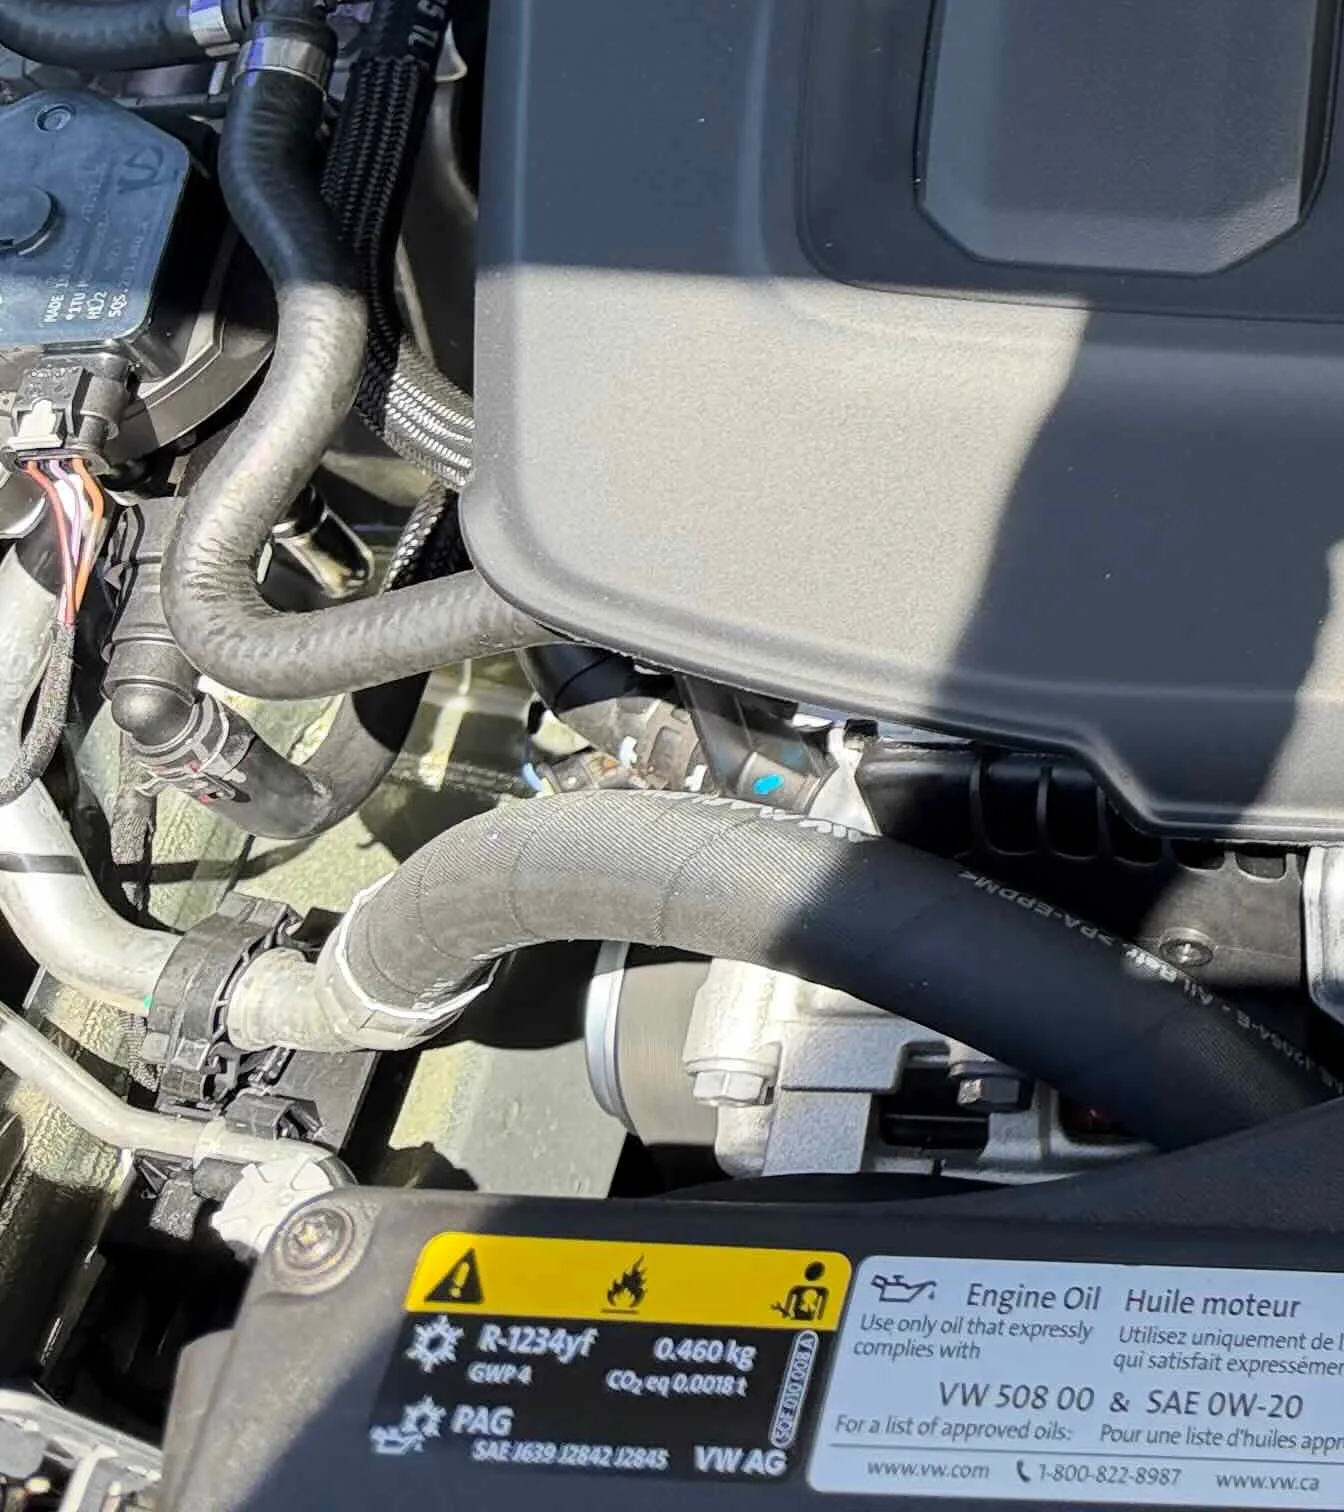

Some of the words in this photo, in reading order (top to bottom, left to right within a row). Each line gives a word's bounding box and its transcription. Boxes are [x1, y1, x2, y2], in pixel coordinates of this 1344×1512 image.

[966, 1282, 1057, 1314] Engine
[1063, 1286, 1099, 1311] Oil
[1125, 1289, 1194, 1316] Huile
[1202, 1295, 1300, 1320] moteur
[860, 1314, 894, 1332] Use
[897, 1316, 936, 1340] only
[940, 1316, 963, 1335] oil
[966, 1317, 1003, 1338] that
[1009, 1320, 1093, 1344] expressly
[1118, 1325, 1185, 1346] Utilisez
[1192, 1330, 1306, 1354] uniquement
[1310, 1333, 1334, 1352] de
[478, 1324, 599, 1364] R-1234yf
[655, 1336, 724, 1363] 0.460
[725, 1345, 757, 1371] kg
[853, 1338, 935, 1362] complies
[940, 1340, 980, 1359] with
[468, 1363, 516, 1384] GWP
[517, 1366, 533, 1385] 4
[1113, 1351, 1142, 1373] qui
[1148, 1351, 1222, 1373] satisfait
[647, 1377, 670, 1398] eq
[673, 1373, 734, 1395] 0.0018
[735, 1376, 748, 1395] t
[939, 1382, 989, 1408] VW
[995, 1383, 1048, 1409] 508
[1057, 1386, 1095, 1410] 00
[1110, 1391, 1129, 1413] &
[1146, 1389, 1199, 1415] SAE
[1207, 1392, 1303, 1419] 0W-20
[452, 1405, 513, 1436] PAG
[835, 1414, 865, 1433] For
[868, 1418, 880, 1435] a
[884, 1415, 913, 1437] list
[918, 1417, 939, 1437] of
[941, 1418, 1028, 1444] approved
[1032, 1420, 1073, 1441] oils:
[473, 1439, 509, 1461] SAE
[1099, 1424, 1141, 1443] Pour
[1145, 1428, 1179, 1446] une
[1184, 1427, 1222, 1446] liste
[1226, 1428, 1296, 1450] d'huiles
[694, 1445, 741, 1472] VW
[742, 1448, 787, 1475] AG
[867, 1459, 989, 1480] www.vw.com
[1038, 1463, 1182, 1486] 1-800-822-8987
[1216, 1471, 1320, 1492] www.vw.ca
